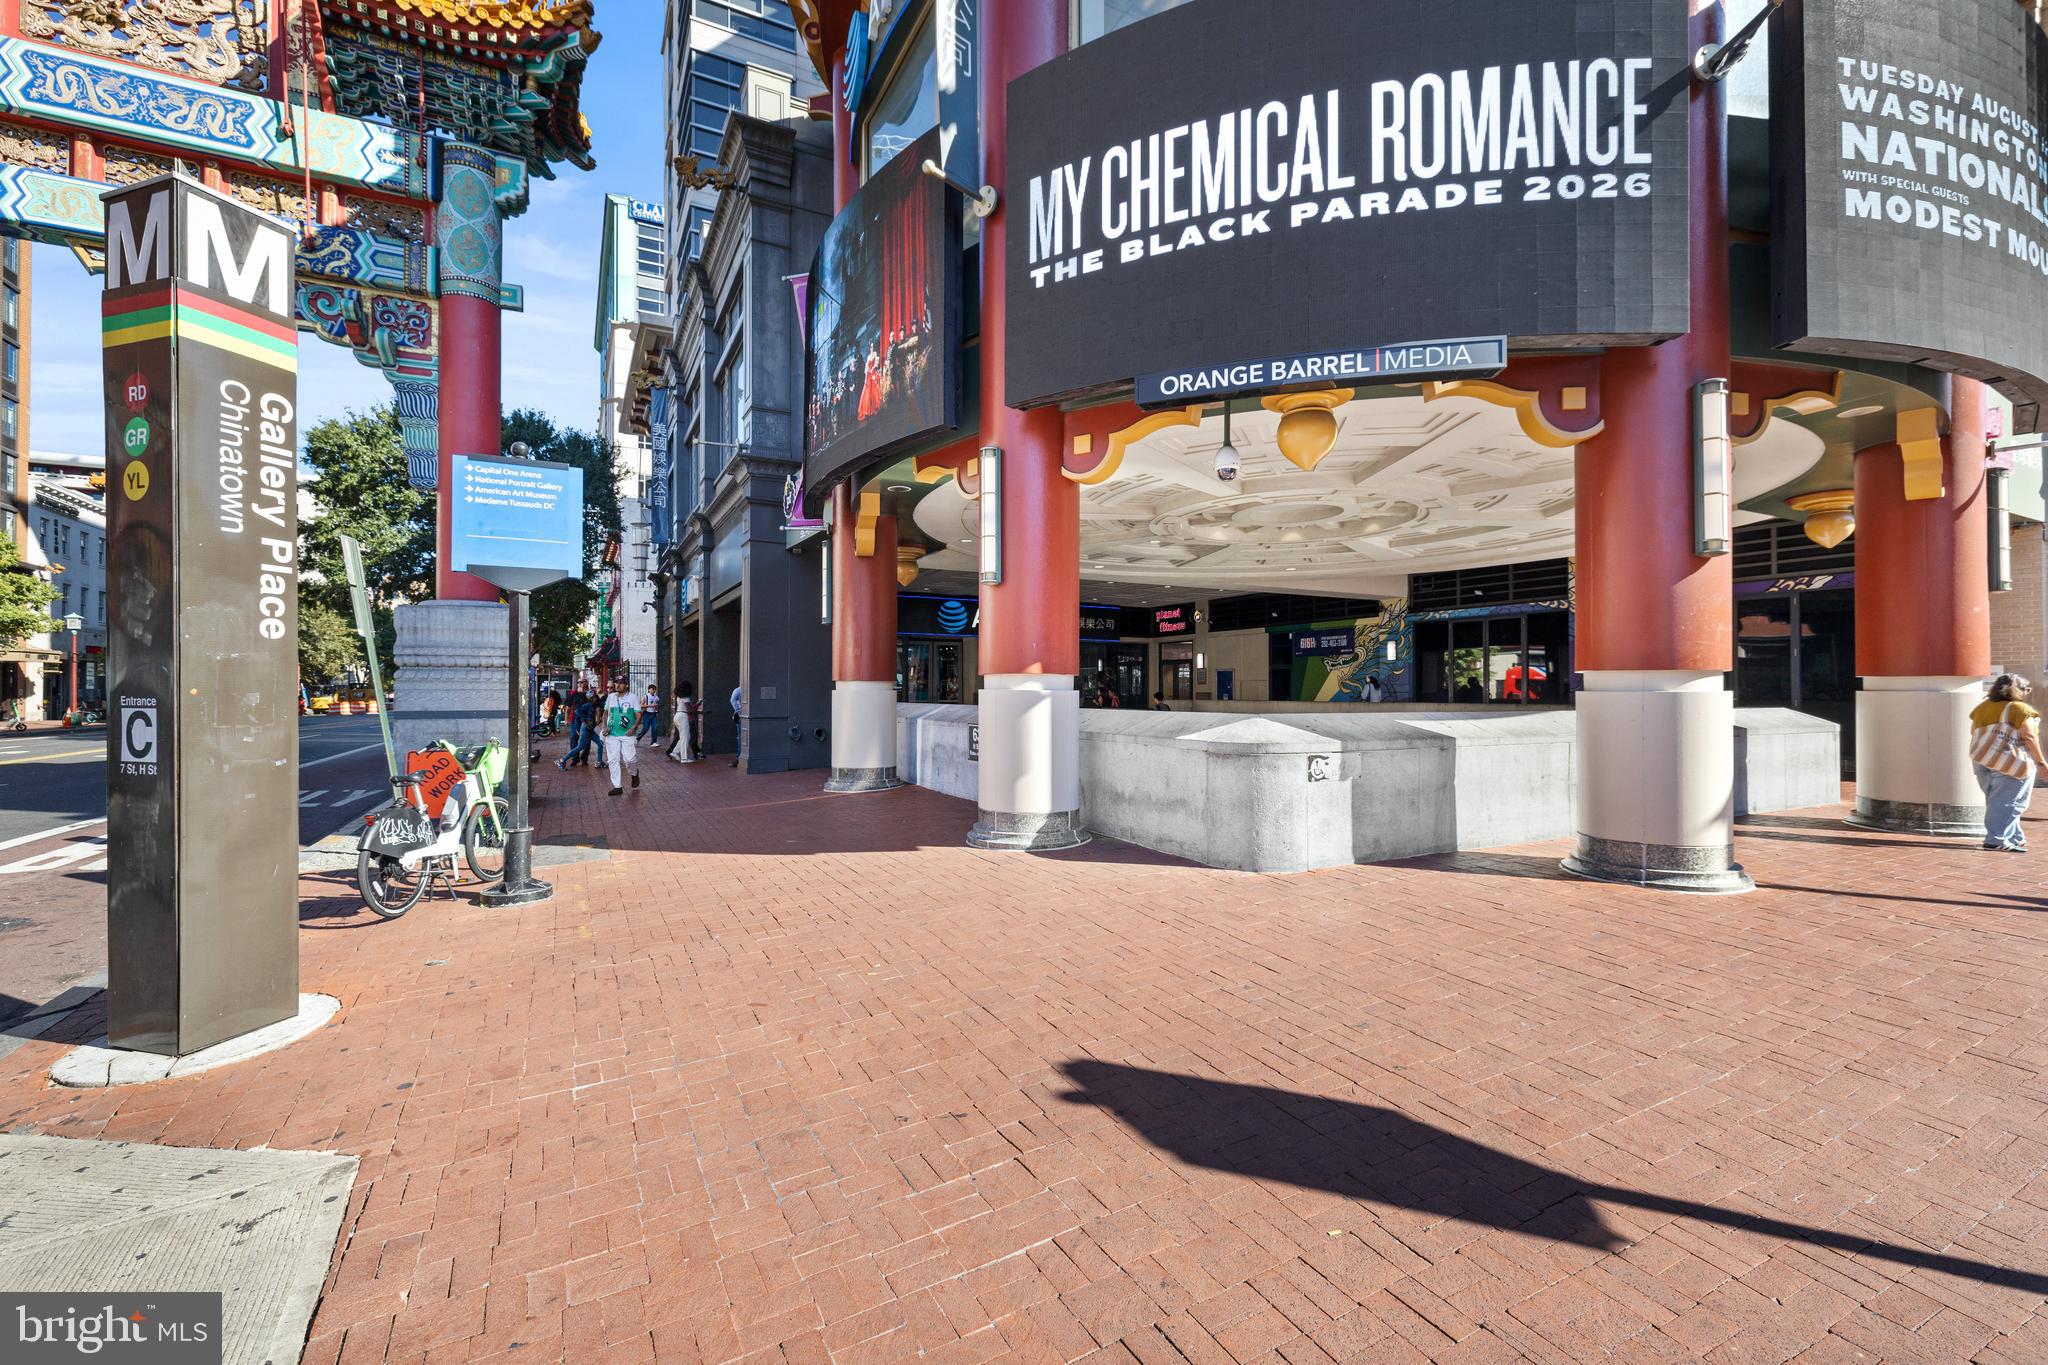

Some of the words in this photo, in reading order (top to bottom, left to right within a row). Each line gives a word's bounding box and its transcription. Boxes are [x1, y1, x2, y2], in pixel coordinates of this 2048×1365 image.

[1838, 56, 1965, 105] TUESDAY
[1971, 92, 2038, 145] AUGUST
[1838, 83, 2048, 185] WASHINGTON
[1029, 155, 1092, 264] MY
[1101, 89, 1356, 240] CHEMICAL
[1371, 57, 1652, 184] ROMANCE
[1842, 169, 1877, 184] WITH
[1881, 176, 1929, 194] SPECIAL
[1931, 185, 1970, 206] GUESTS
[1030, 249, 1104, 289] THE
[1120, 209, 1271, 264] BLACK
[1290, 179, 1503, 228] PARADE
[1523, 173, 1652, 201] 2026
[1845, 187, 2001, 248] MODEST
[107, 189, 170, 290] M
[187, 192, 288, 318] M
[1159, 363, 1264, 396] ORANGE
[1271, 352, 1370, 381] BARREL
[1384, 344, 1472, 370] MEDIA
[128, 384, 147, 402] RD
[125, 427, 147, 447] GR
[219, 379, 251, 534] Chinatown
[127, 472, 146, 490] YL
[251, 392, 294, 528] Gallery
[474, 465, 502, 475] Capital
[503, 468, 519, 477] One
[519, 470, 542, 479] Arena
[652, 422, 668, 508] 美國娛樂公司
[474, 486, 511, 496] American
[512, 489, 525, 497] Art
[525, 491, 557, 500] Museum
[474, 496, 508, 506] Madame
[508, 499, 543, 509] Tussauds
[475, 475, 508, 486] National
[508, 478, 536, 489] Portrait
[536, 482, 563, 492] Gallery
[258, 537, 293, 640] Place
[1155, 608, 1181, 621] planet
[1160, 621, 1186, 633] fitness
[120, 695, 157, 706] Entrance
[126, 710, 153, 759] C
[120, 763, 125, 773] 7
[126, 763, 138, 776] St,
[139, 764, 146, 775] H
[147, 764, 158, 775] St
[428, 767, 464, 798] WORK
